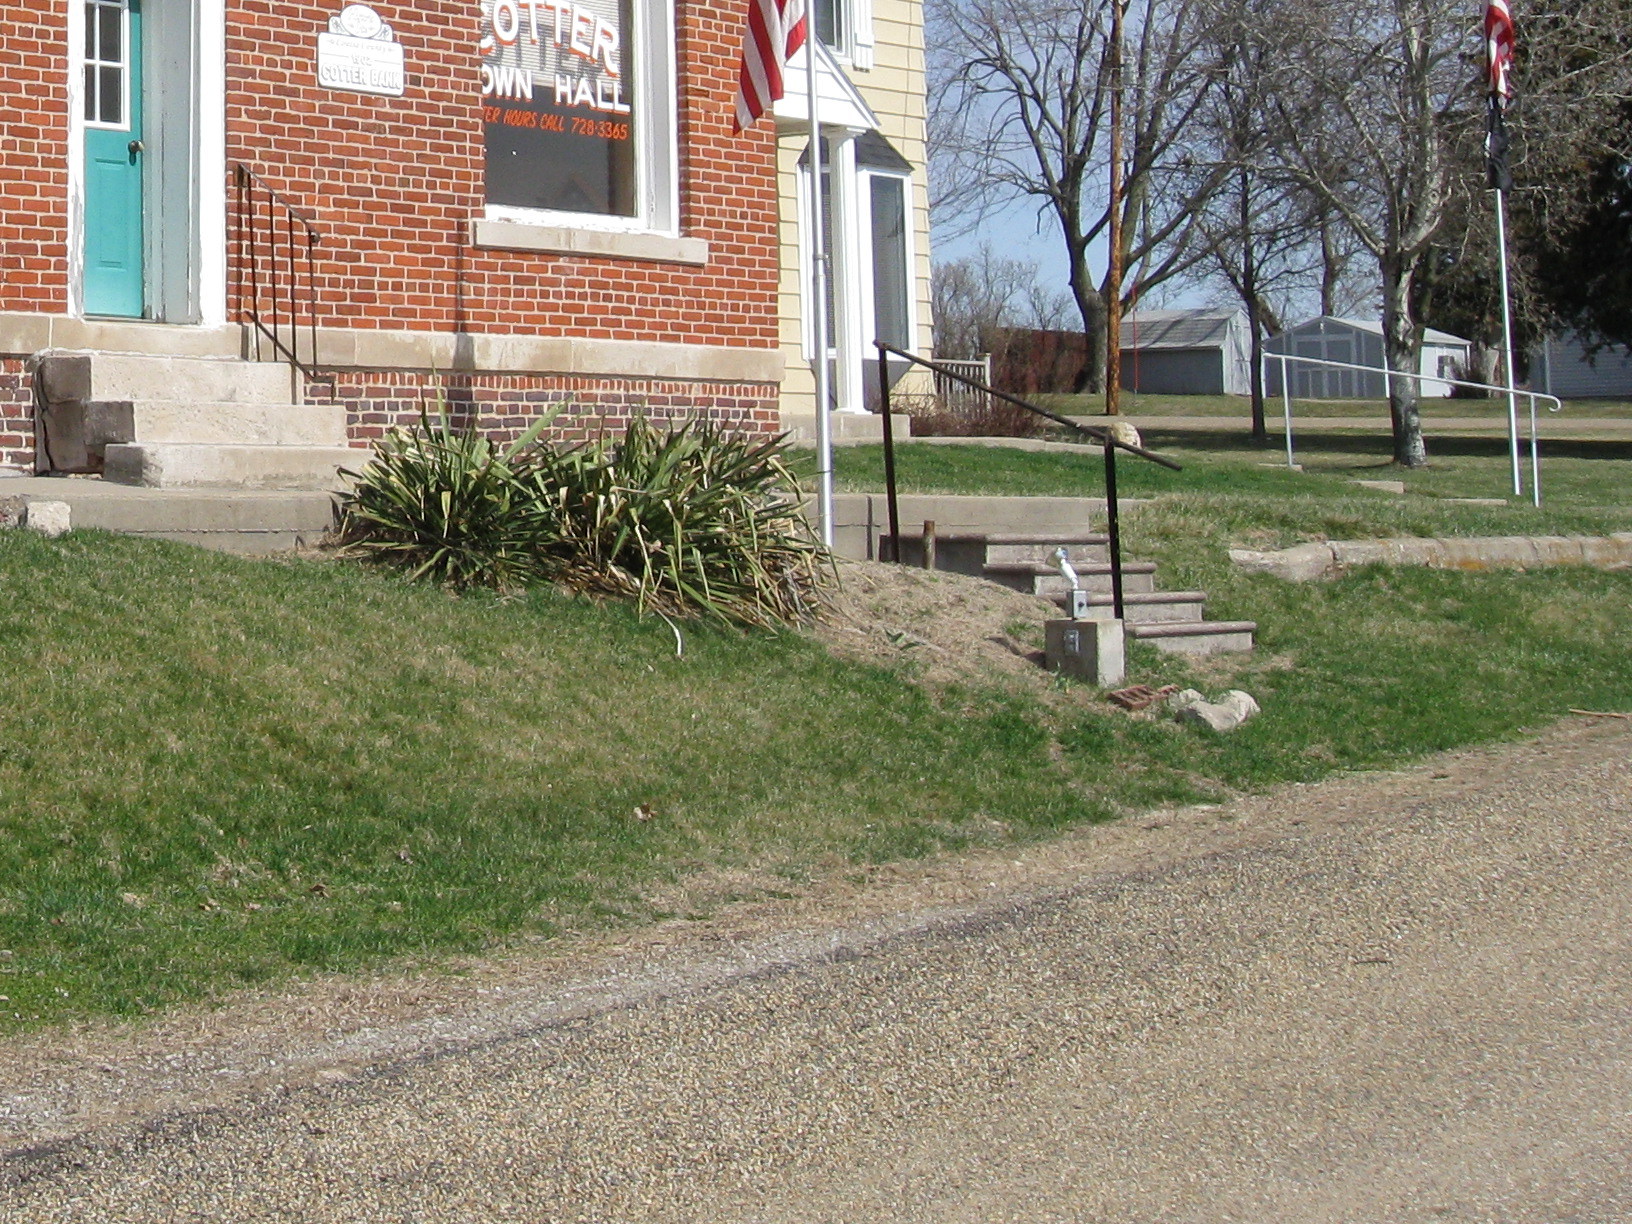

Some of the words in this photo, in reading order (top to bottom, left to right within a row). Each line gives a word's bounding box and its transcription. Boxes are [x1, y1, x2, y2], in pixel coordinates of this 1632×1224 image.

[321, 62, 367, 86] COTTER
[370, 68, 402, 90] BANK
[482, 63, 533, 100] OWN
[554, 74, 630, 114] HALL
[504, 109, 538, 128] HOURS
[540, 114, 564, 132] CALL
